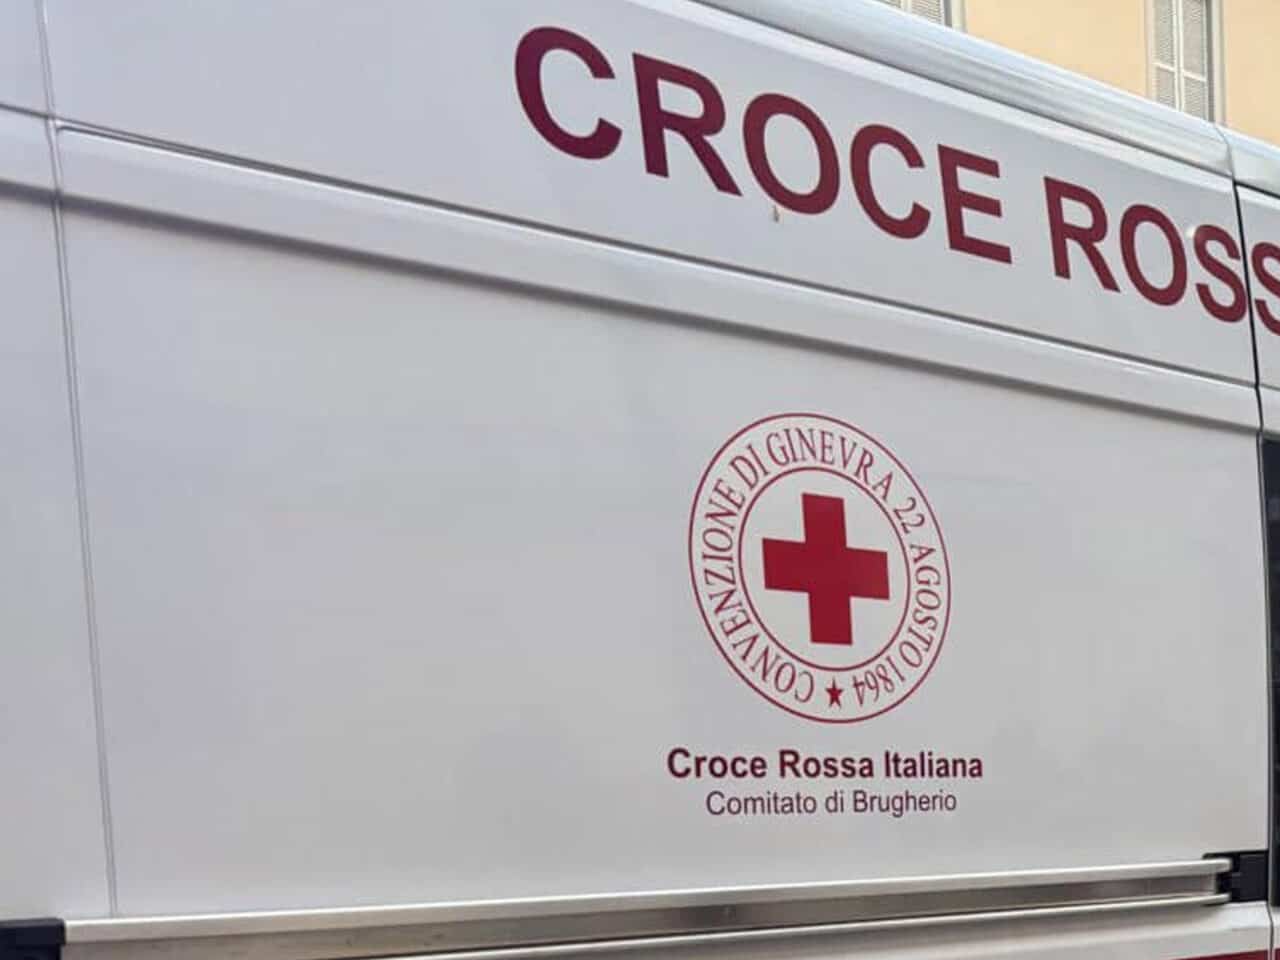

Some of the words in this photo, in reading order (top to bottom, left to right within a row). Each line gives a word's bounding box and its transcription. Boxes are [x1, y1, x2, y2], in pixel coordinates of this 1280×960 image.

[514, 25, 1013, 265] CROCE
[729, 443, 767, 492] DI
[766, 427, 894, 502] GINEVRA
[894, 496, 925, 535] 22
[701, 478, 814, 704] CONVENZIONE
[900, 541, 942, 670] AGOSTO
[852, 655, 906, 707] 1864
[667, 748, 767, 779] Croce
[779, 749, 874, 779] Rossa
[885, 750, 983, 778] Italiana
[706, 790, 817, 816] Comitato
[826, 790, 844, 814] di
[854, 788, 957, 817] Brugherio
